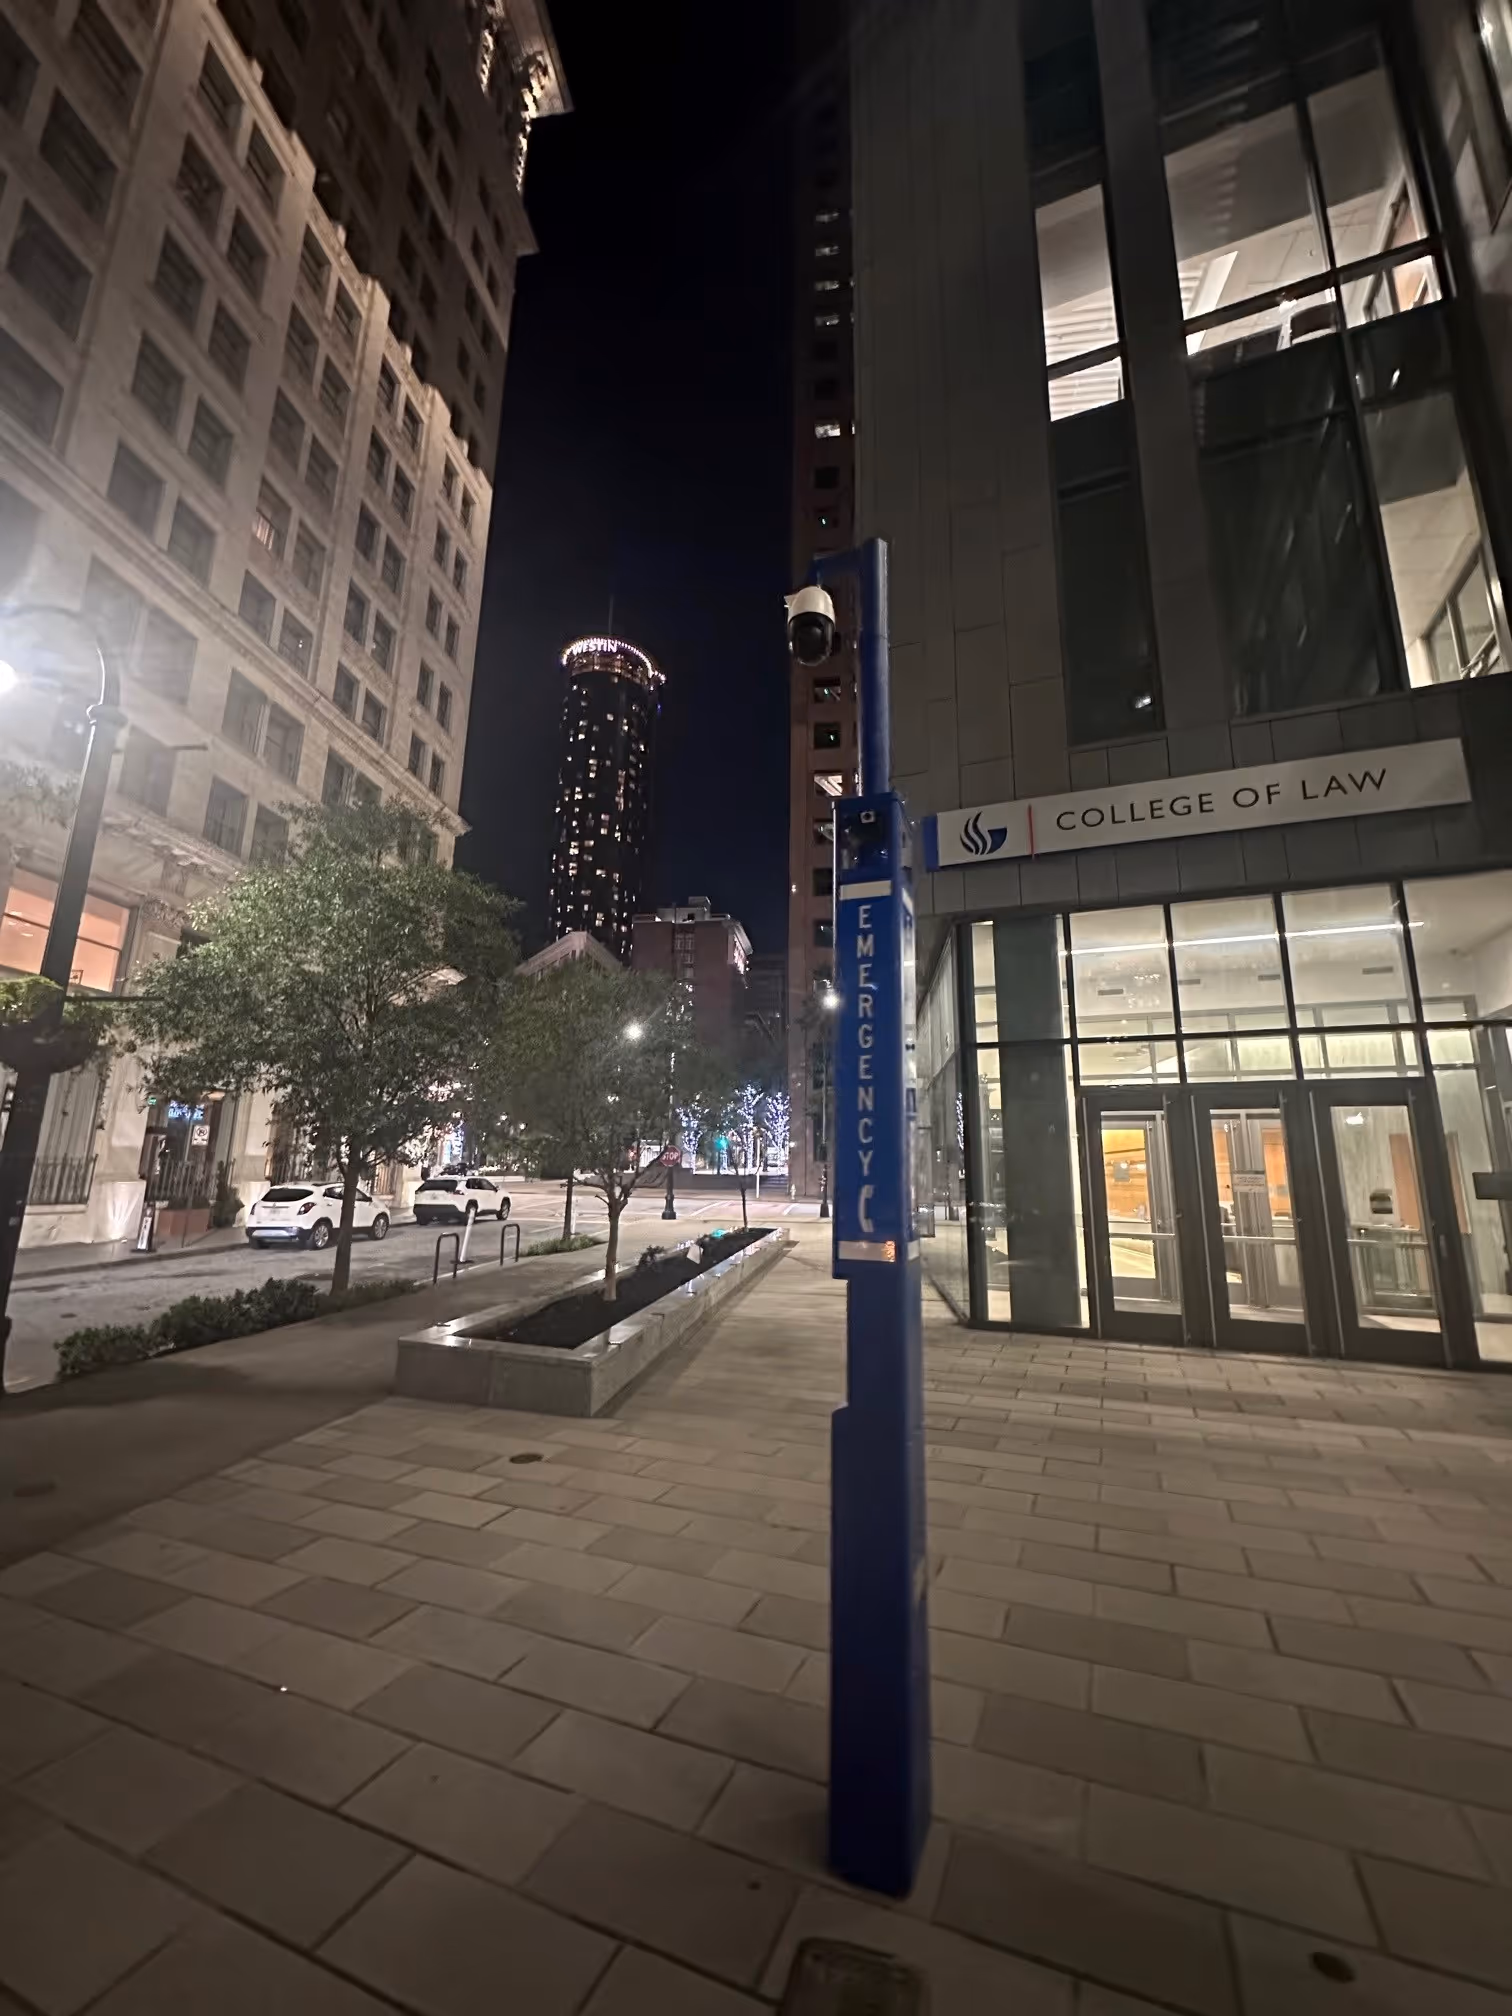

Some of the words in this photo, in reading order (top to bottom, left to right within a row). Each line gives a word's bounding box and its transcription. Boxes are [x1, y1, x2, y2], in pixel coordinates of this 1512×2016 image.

[571, 639, 617, 655] WESTIN
[1056, 793, 1214, 831] COLLEGE
[1232, 783, 1281, 809] OF
[1302, 768, 1387, 801] LAW
[856, 905, 874, 1175] EMERGENCY
[662, 1152, 679, 1160] STOP
